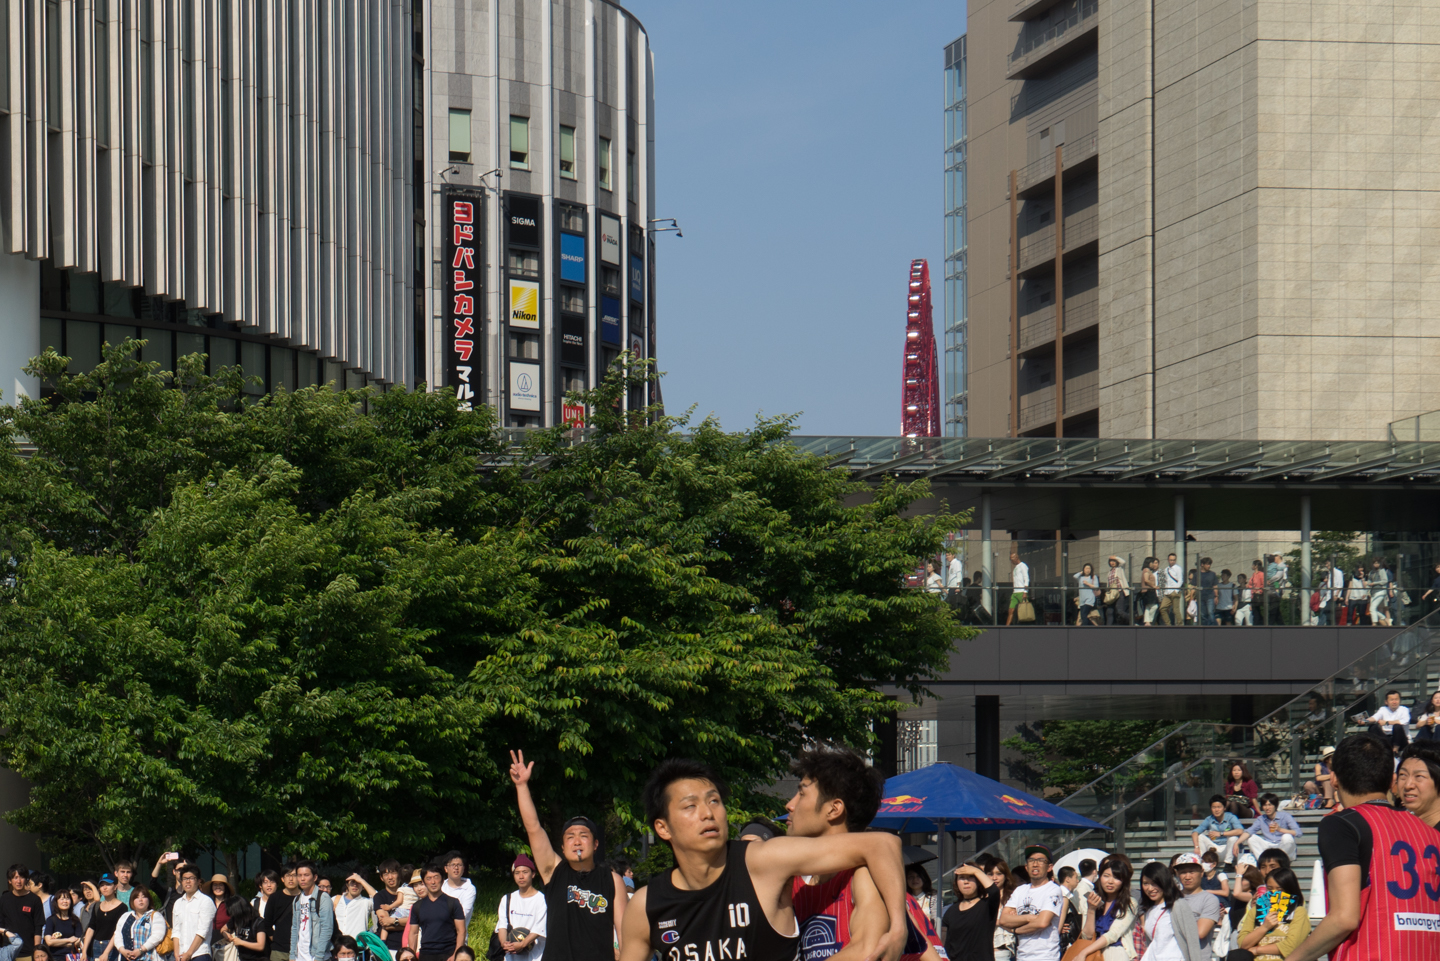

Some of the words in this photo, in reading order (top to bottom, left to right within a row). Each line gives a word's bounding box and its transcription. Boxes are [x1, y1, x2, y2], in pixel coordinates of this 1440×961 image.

[511, 216, 536, 227] SIGMA
[561, 253, 584, 263] SHARP
[452, 200, 475, 361] ヨドバシカメラ
[512, 310, 537, 321] Nikon
[563, 333, 583, 342] HITACHI
[888, 805, 924, 813] Bull
